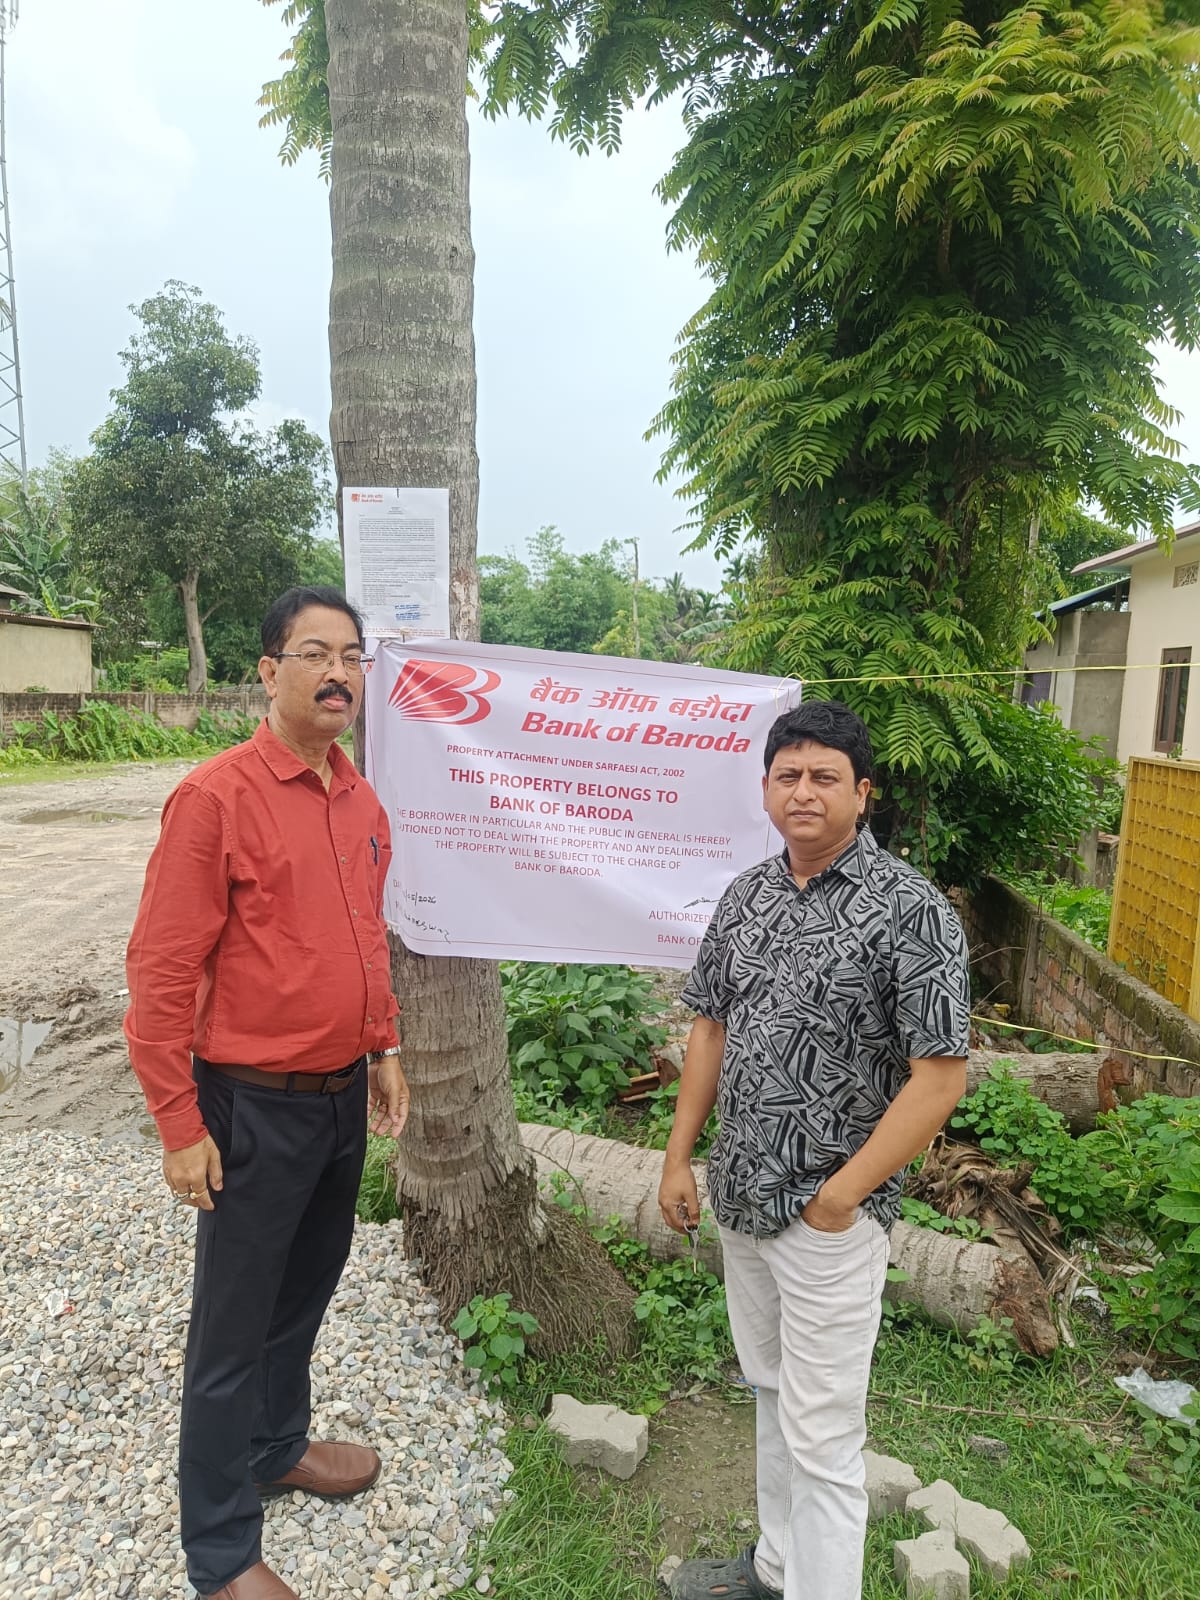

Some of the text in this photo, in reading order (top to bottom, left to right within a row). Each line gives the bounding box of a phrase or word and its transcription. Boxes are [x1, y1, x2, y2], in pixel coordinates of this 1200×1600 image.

[529, 677, 583, 704] बैंक
[668, 694, 756, 723] बड़ौदा
[521, 711, 752, 753] Bank of Baroda
[447, 744, 685, 778] PROPERTY ATTACHMENT UNDER SARFAESI ACT, 2002
[449, 768, 678, 804] THIS PROPERTY BELONGS TO
[490, 795, 634, 822] BANK OF BARODA
[409, 810, 467, 823] BORROWER
[469, 814, 480, 824] IN
[482, 815, 542, 830] PARTICULAR
[544, 822, 566, 832] AND
[568, 824, 586, 834] THE
[588, 826, 622, 838] PUBLIC
[624, 829, 635, 839] IN
[637, 830, 681, 842] GENERAL
[683, 834, 692, 843] IS
[694, 835, 731, 846] HEREBY
[444, 827, 466, 837] NOT
[468, 829, 482, 838] TO
[484, 830, 508, 841] DEAL
[511, 833, 537, 844] WITH
[540, 835, 559, 846] THE
[561, 838, 610, 850] PROPERTY
[612, 842, 633, 853] AND
[634, 844, 655, 854] ANY
[657, 846, 704, 857] DEALINGS
[706, 849, 733, 860] WITH
[435, 840, 681, 870] THE PROPERTY WILL BE SUBJECT TO THE CHARGE OF
[514, 861, 604, 878] BANK OF BARODA.
[648, 910, 711, 924] AUTHORIZED
[657, 934, 702, 946] BANK OF
